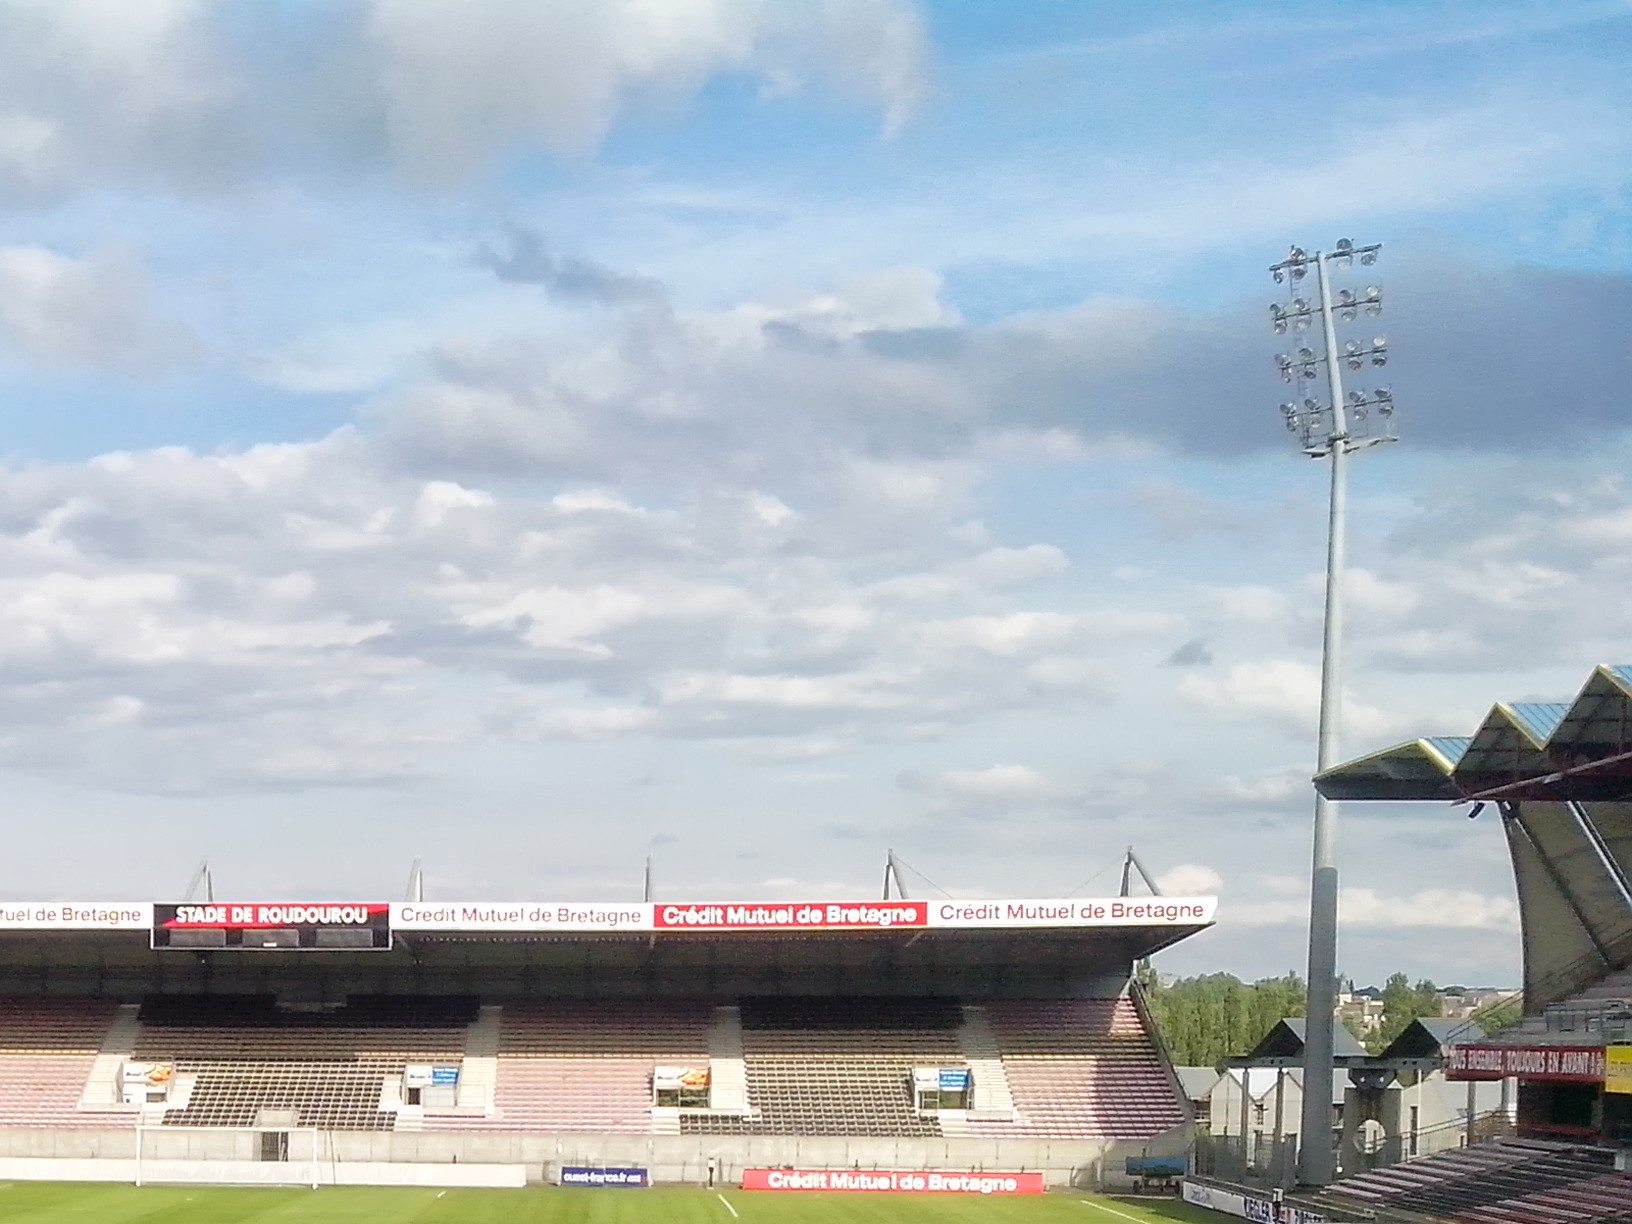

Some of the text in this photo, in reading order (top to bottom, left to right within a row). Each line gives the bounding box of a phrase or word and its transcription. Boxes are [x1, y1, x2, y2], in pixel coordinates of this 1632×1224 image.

[35, 907, 56, 921] de
[62, 907, 141, 925] Bretagne
[176, 906, 368, 924] STADE DE ROUDOUROU
[462, 907, 523, 922] Mutuel
[529, 907, 552, 922] de
[558, 908, 641, 926] Bretagne
[662, 905, 917, 926] Crédit Mutuel de Bretagne
[940, 903, 1204, 921] Crédit Mutuel de Bretagne
[767, 1171, 1017, 1194] Crédit Mutuel de Bretagne
